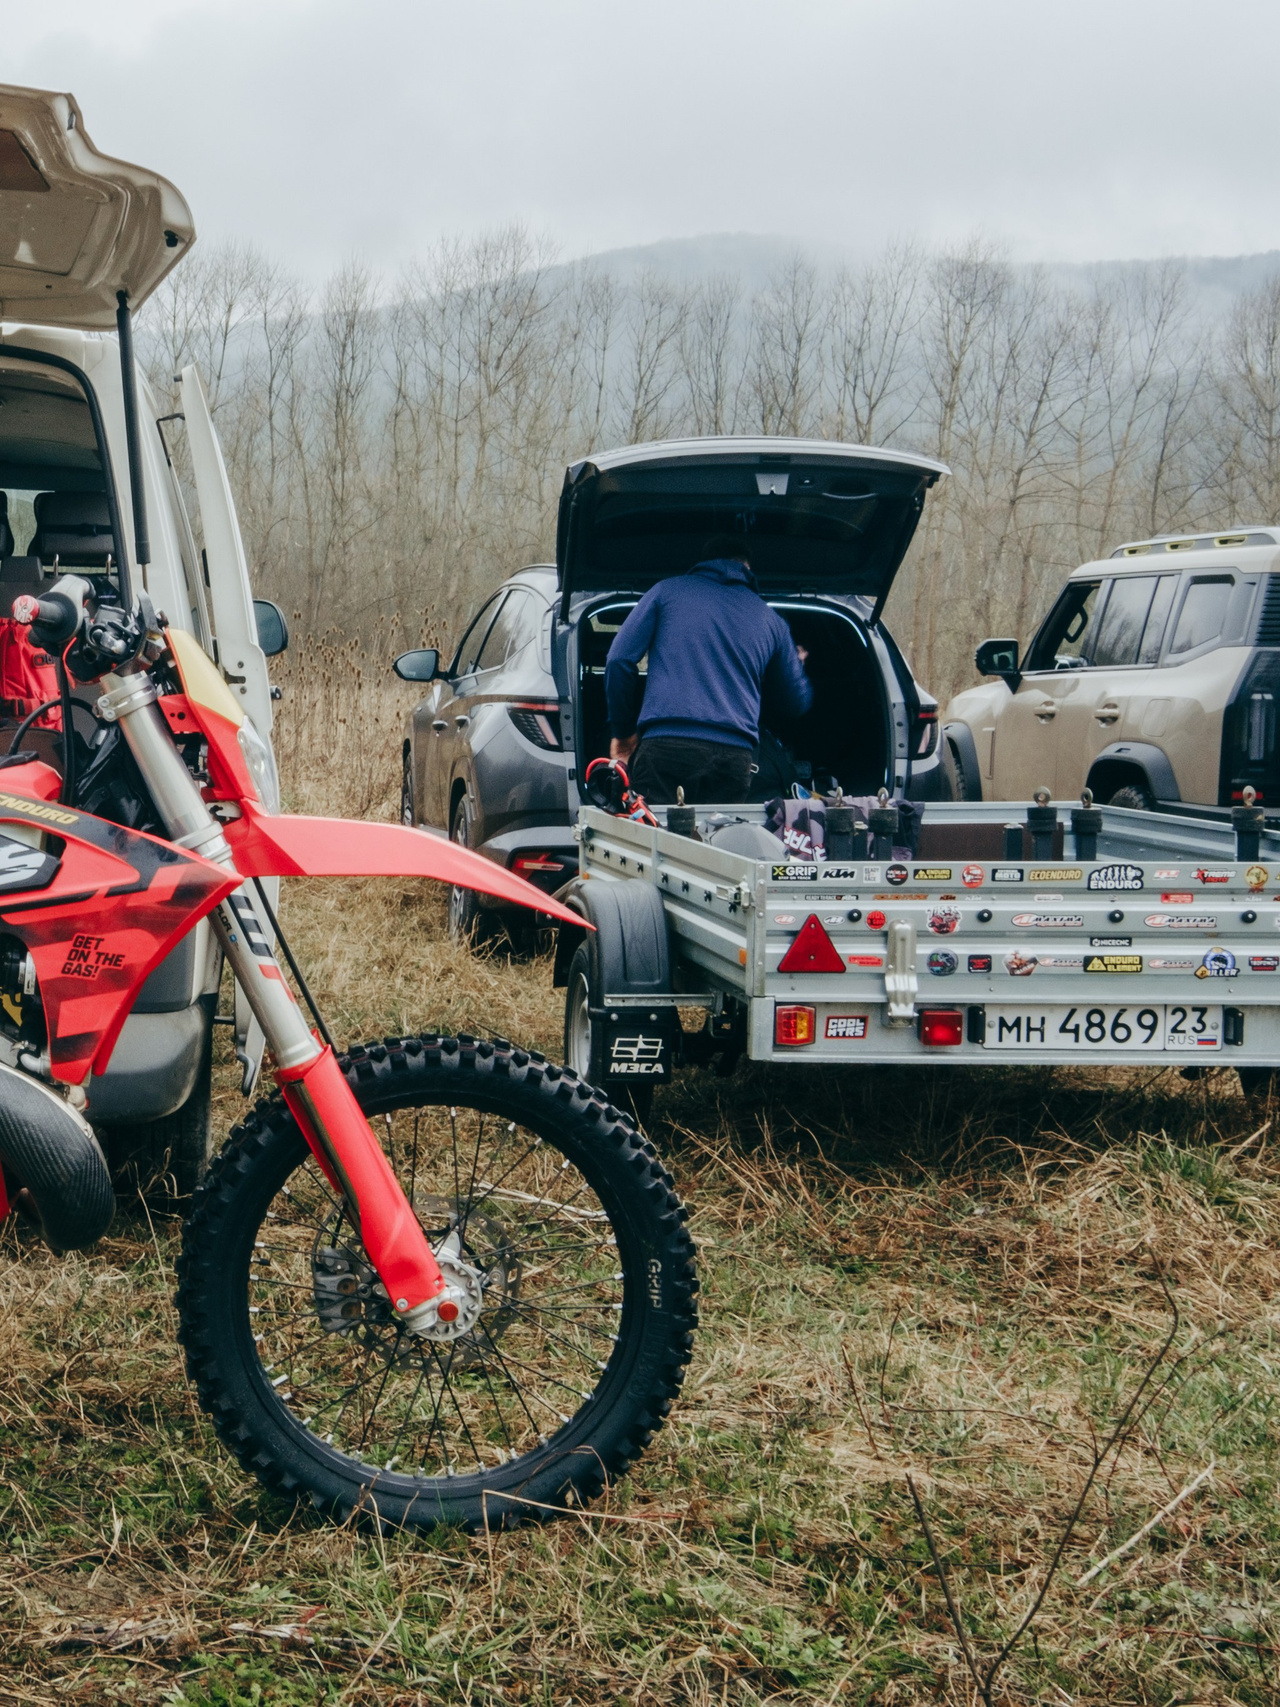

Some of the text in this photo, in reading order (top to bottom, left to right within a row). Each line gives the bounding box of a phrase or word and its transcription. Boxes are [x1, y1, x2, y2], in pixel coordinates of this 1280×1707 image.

[773, 866, 817, 876] X-GRIP
[822, 868, 855, 879] KTM
[1029, 870, 1081, 881] ECOENDURO
[1090, 879, 1142, 889] ENDURO
[73, 935, 105, 950] GET
[1101, 938, 1130, 946] NICECNC
[67, 948, 126, 967] ON THE
[1103, 956, 1140, 964] ENDURO
[61, 961, 99, 978] GAS!
[1107, 964, 1142, 972] ELEMENT
[828, 1018, 865, 1028] COOL
[1058, 1008, 1159, 1044] 4869
[1170, 1007, 1208, 1034] 23
[827, 1027, 865, 1037] MTRS
[1168, 1035, 1195, 1045] RUS
[610, 1063, 665, 1074] МЗСА
[648, 1258, 663, 1309] GRIP
